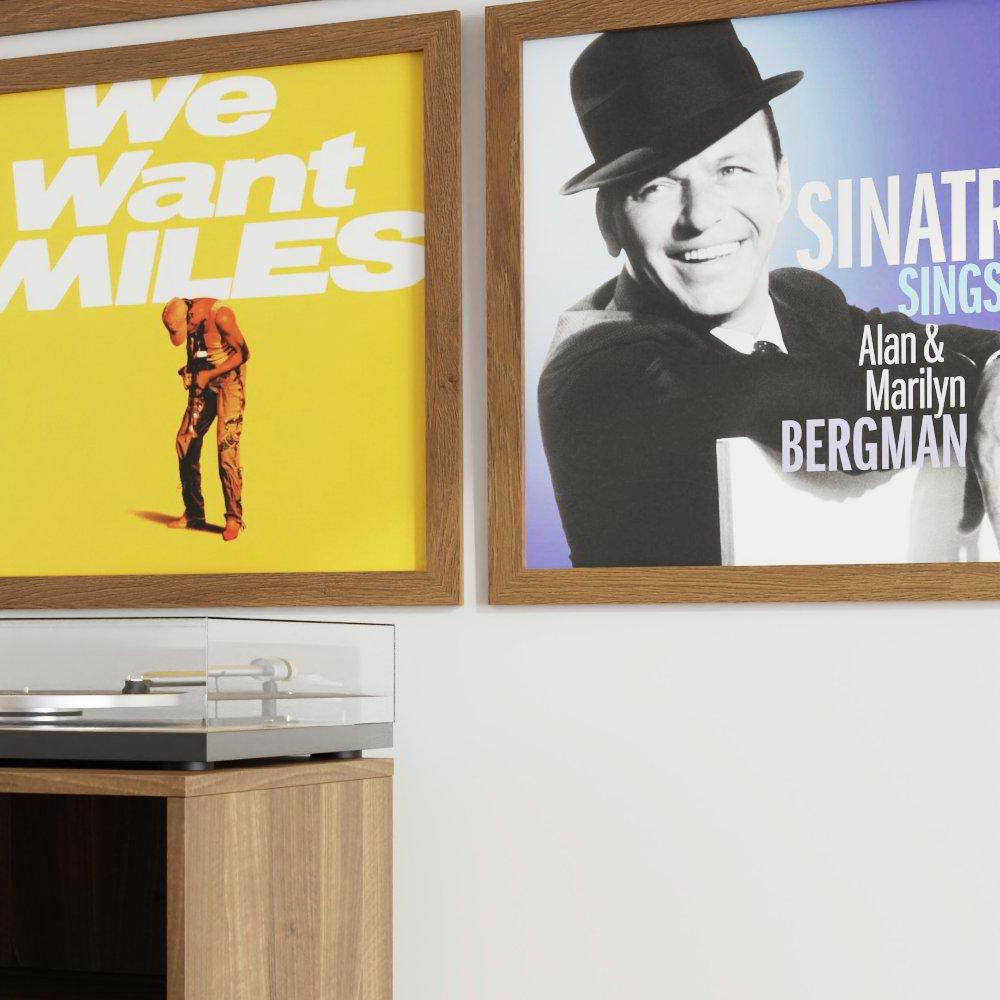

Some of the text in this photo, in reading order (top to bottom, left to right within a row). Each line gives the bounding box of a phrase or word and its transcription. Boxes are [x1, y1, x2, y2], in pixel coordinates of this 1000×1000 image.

[63, 74, 277, 149] We
[12, 132, 365, 231] Want
[898, 262, 1000, 318] SINGS
[858, 323, 945, 367] Alan &
[866, 369, 966, 418] Marilyn
[781, 413, 968, 473] BERGMAN
